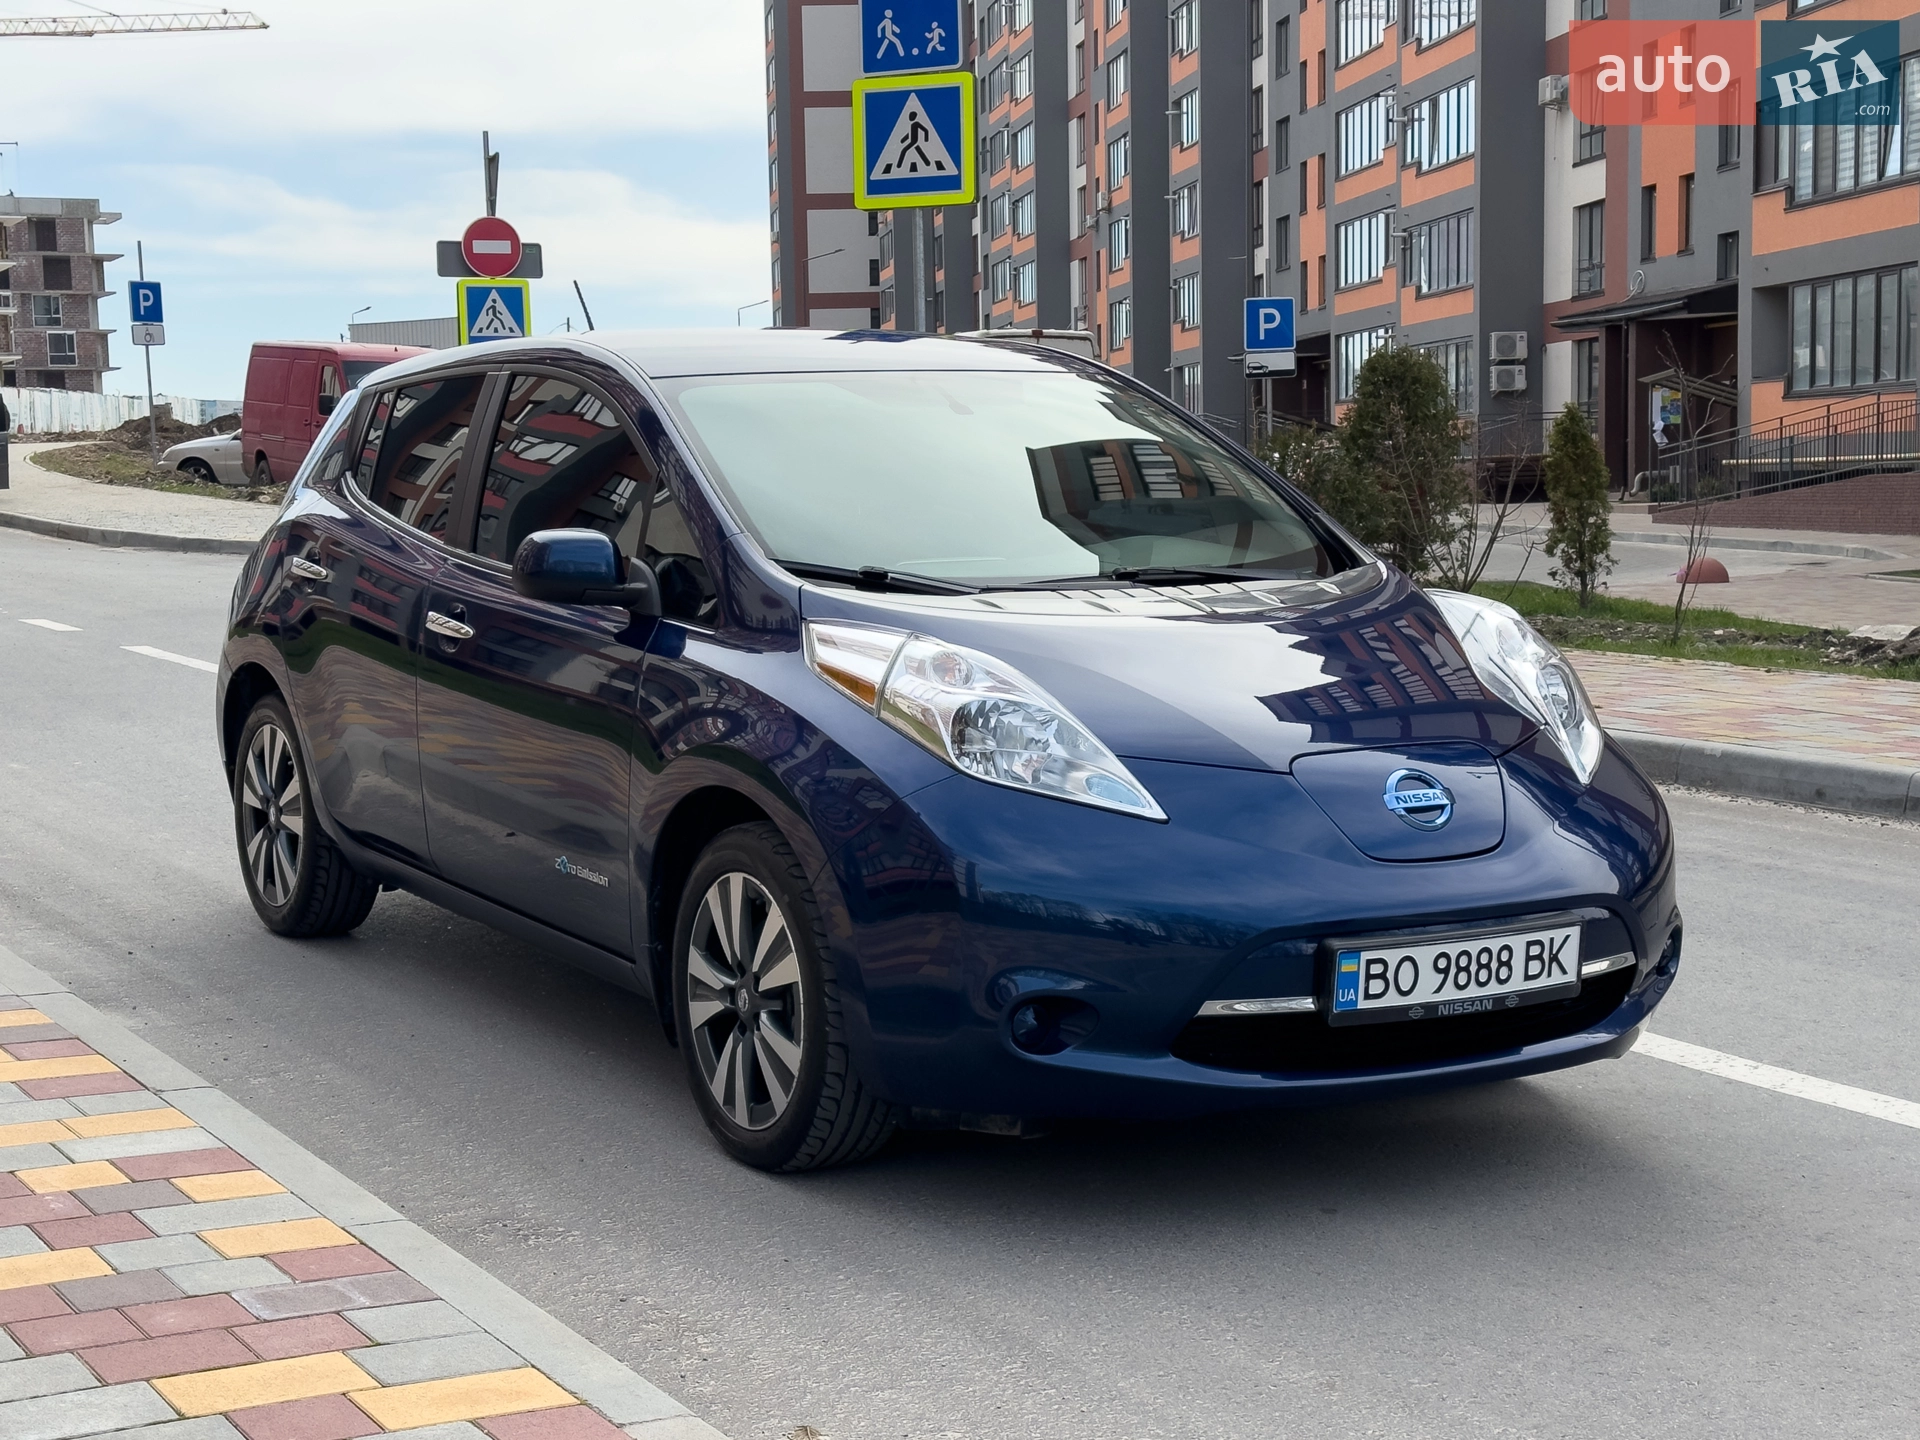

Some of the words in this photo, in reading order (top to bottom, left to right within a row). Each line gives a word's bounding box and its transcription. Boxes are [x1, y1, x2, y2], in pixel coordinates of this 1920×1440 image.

[138, 288, 154, 315] P
[1259, 308, 1281, 340] P
[1394, 792, 1448, 805] NISSAN
[1363, 955, 1419, 1001] BO
[1431, 943, 1514, 994] 9888
[1523, 934, 1571, 982] BK
[1339, 988, 1356, 1002] UA
[1437, 999, 1493, 1016] NISSAN
